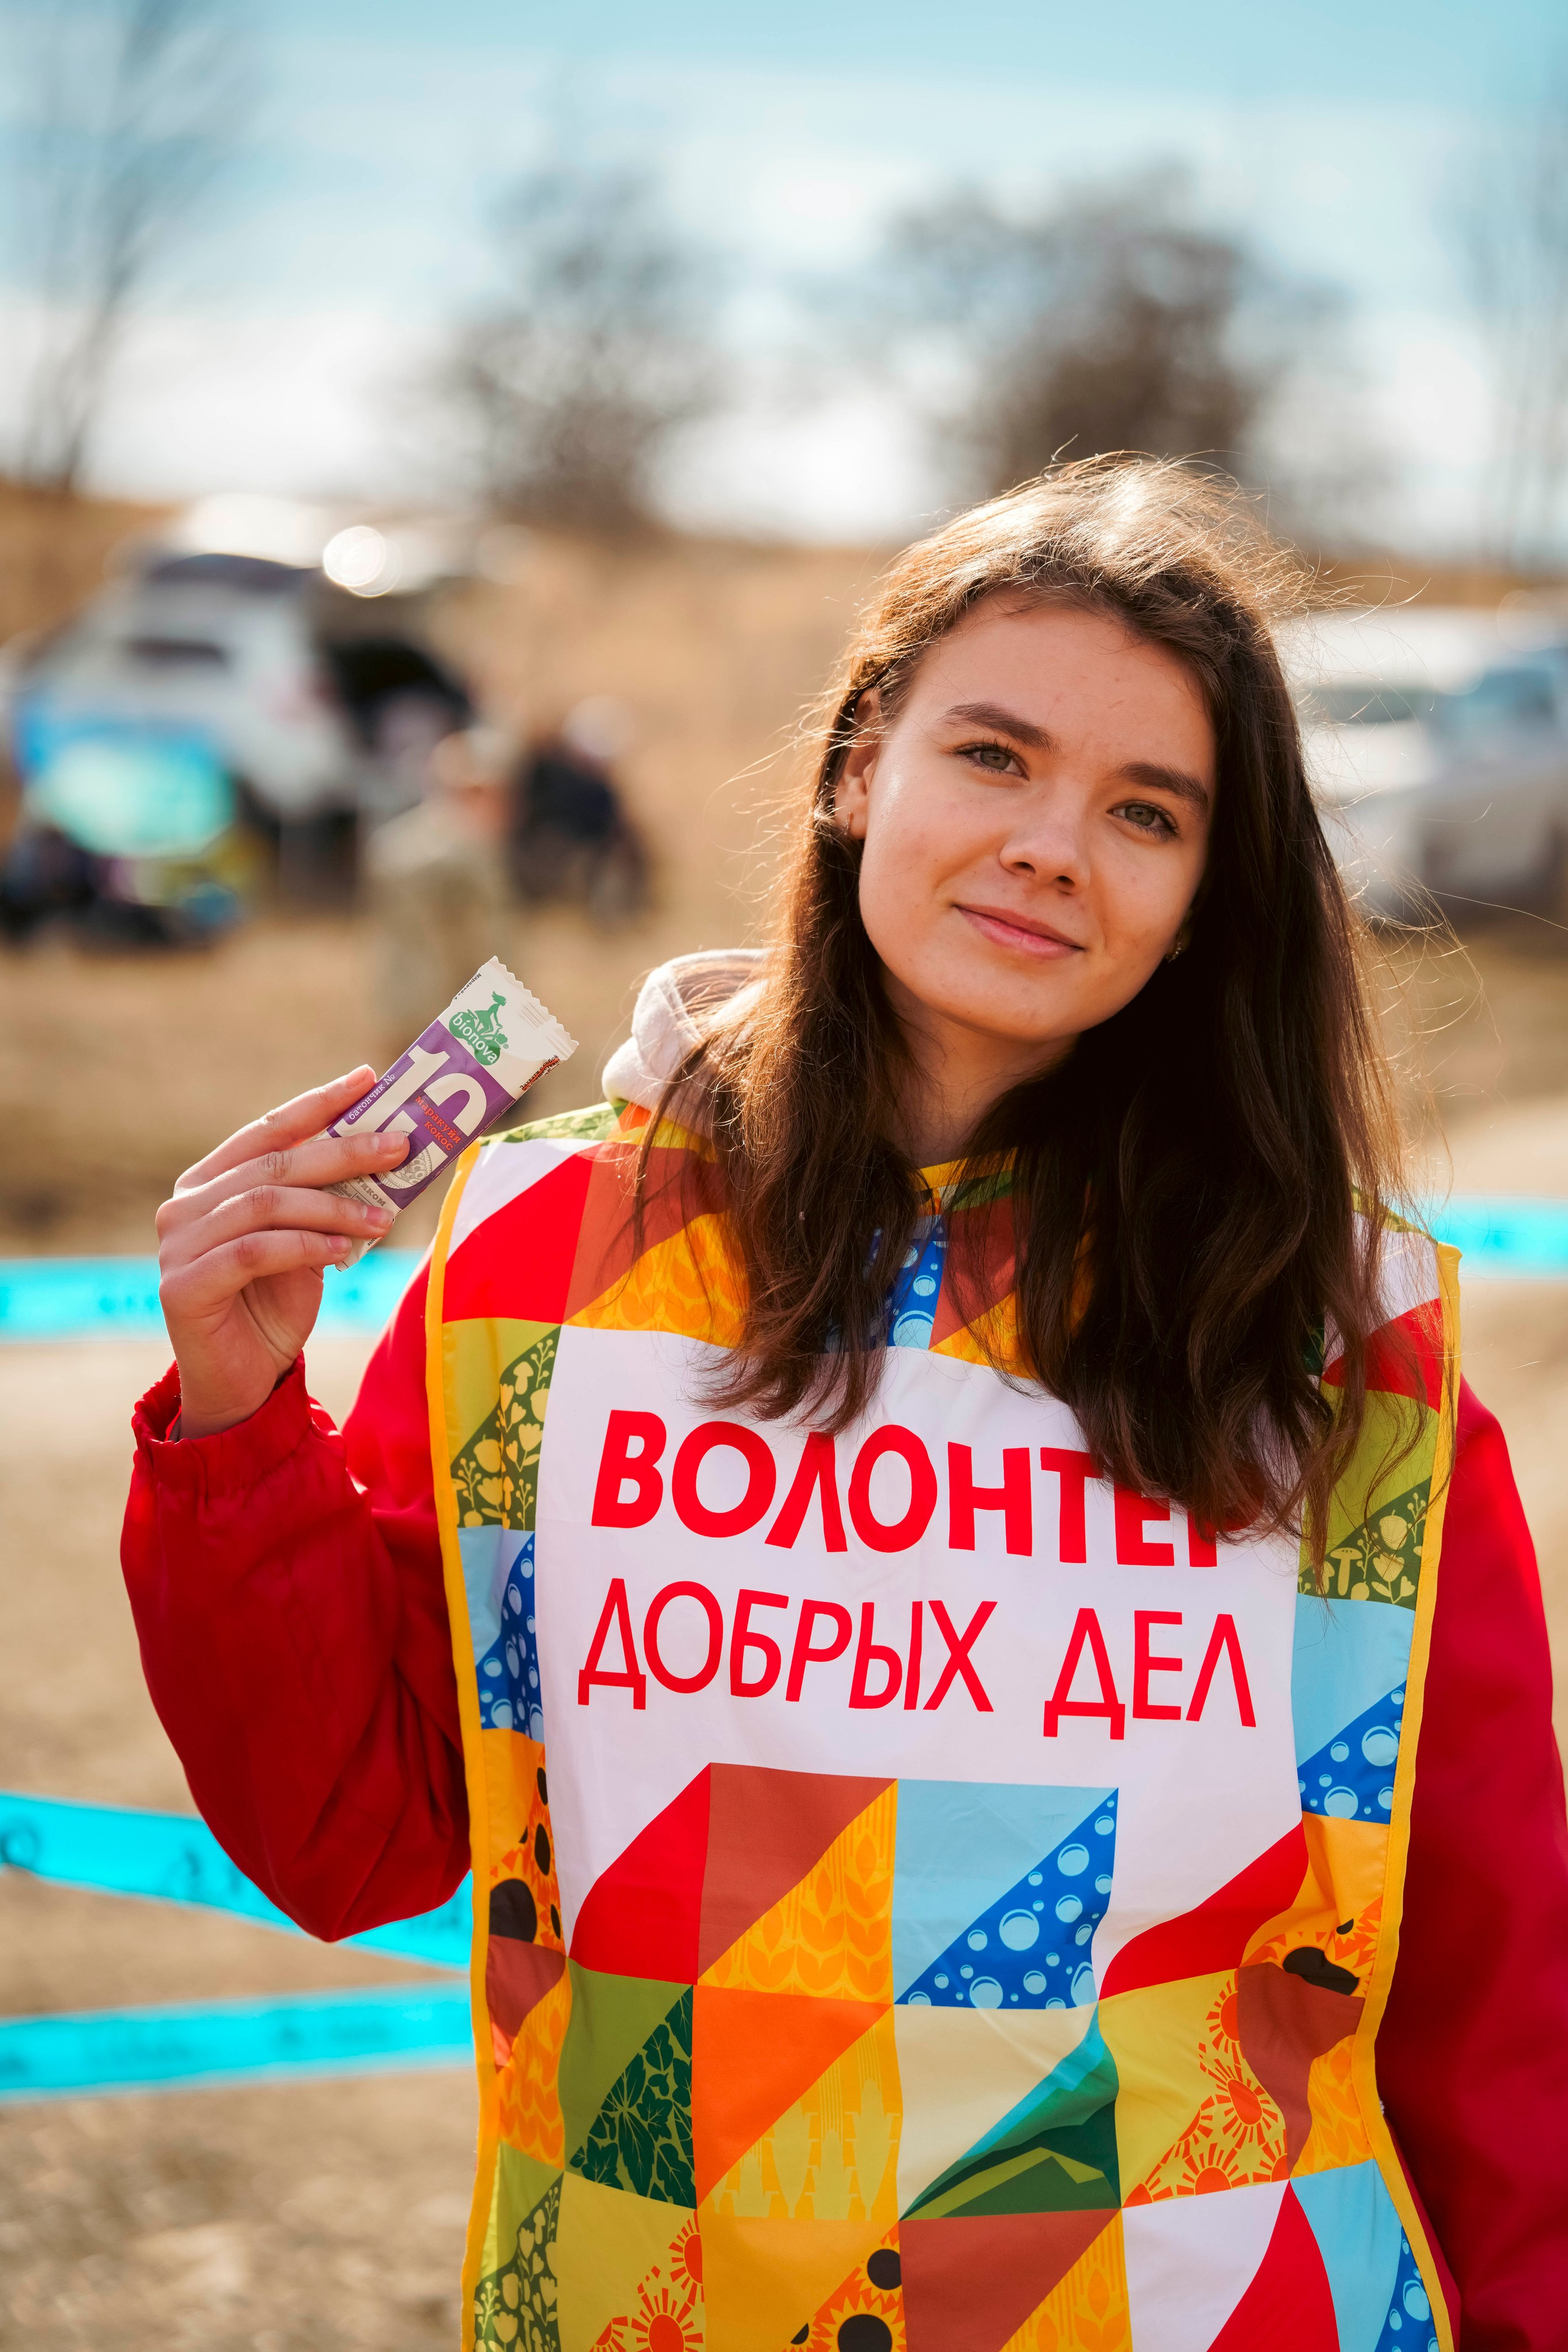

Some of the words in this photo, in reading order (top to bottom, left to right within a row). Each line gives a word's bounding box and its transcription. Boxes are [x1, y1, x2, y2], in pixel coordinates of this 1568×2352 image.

[452, 1012, 497, 1064] bionova
[349, 1084, 385, 1120] батончик
[383, 1074, 396, 1085] №
[519, 1071, 540, 1090] Захвати
[415, 1095, 462, 1144] маракуйя
[424, 1120, 454, 1150] кокос
[578, 1578, 998, 1712] ДОБРЫХ
[1043, 1608, 1256, 1740] ДЕЛ
